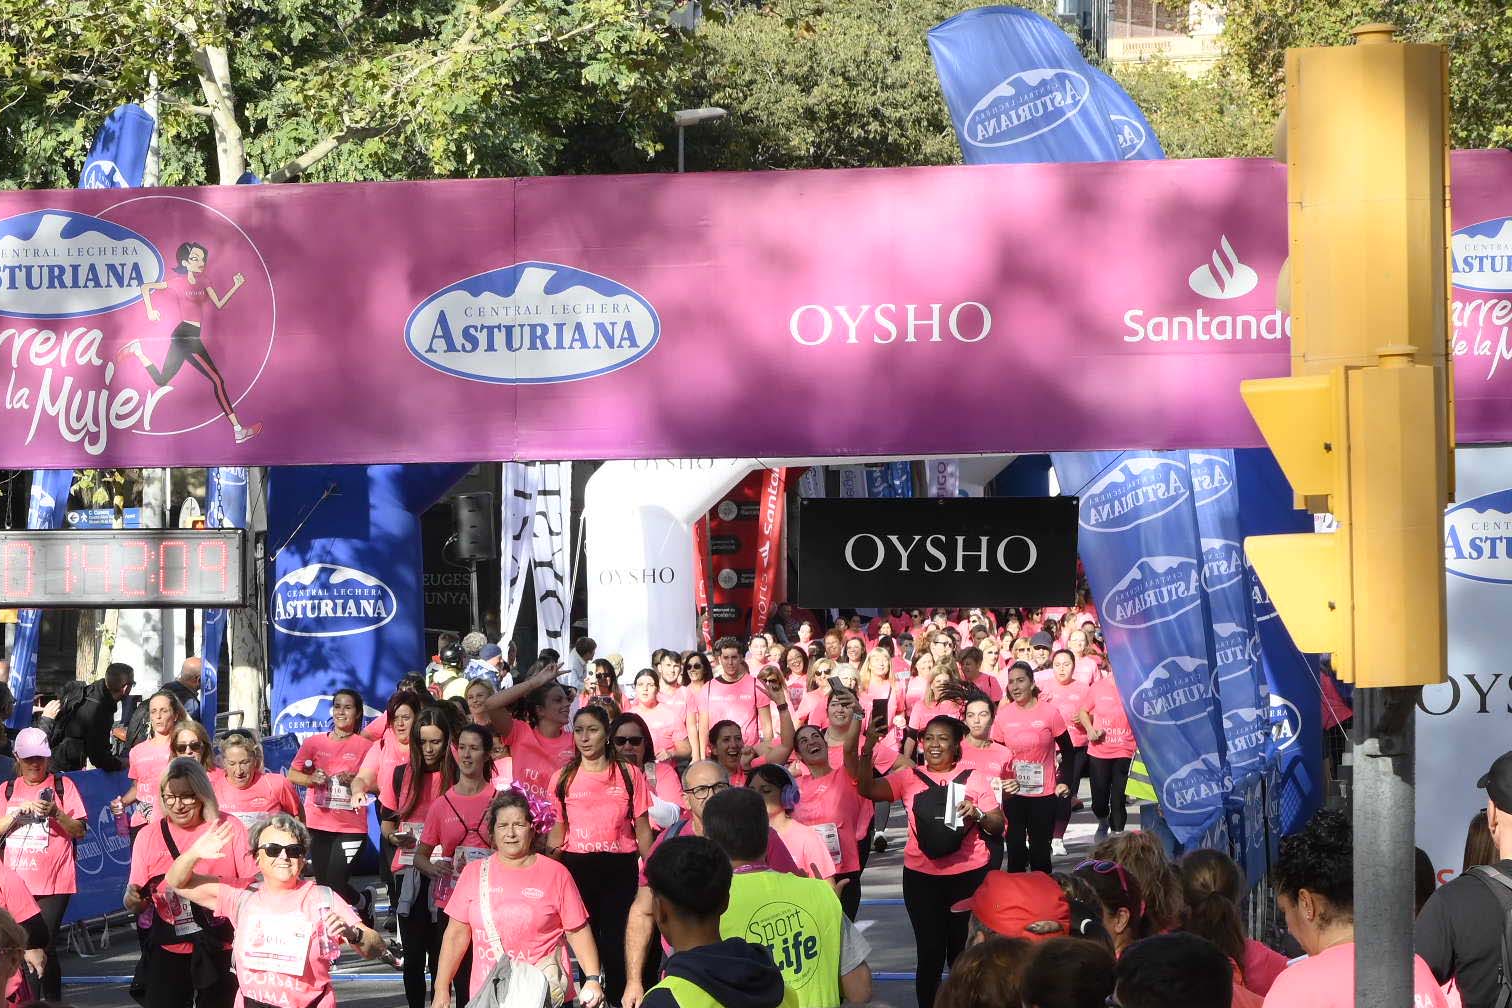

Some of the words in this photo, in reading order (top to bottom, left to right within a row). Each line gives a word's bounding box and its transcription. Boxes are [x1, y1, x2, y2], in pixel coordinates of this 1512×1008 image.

[67, 245, 139, 257] LECHERA
[1464, 243, 1512, 251] CENTRA
[464, 304, 542, 318] CENTRAL
[551, 303, 631, 315] LECHERA
[790, 302, 991, 345] OYSHO
[424, 309, 640, 353] ASTURIANA
[1123, 308, 1291, 341] Santand
[1473, 329, 1492, 357] la
[5, 370, 30, 410] la
[25, 362, 174, 456] Mujer
[845, 534, 1037, 573] OYSHO
[599, 566, 675, 584] OYSHO
[287, 588, 328, 598] CENTRAL
[333, 587, 382, 597] LECHERA
[275, 594, 388, 621] ASTURIANA
[525, 768, 538, 780] TU
[575, 829, 589, 840] TU
[749, 909, 804, 944] Sport
[478, 947, 531, 962] DOSAL
